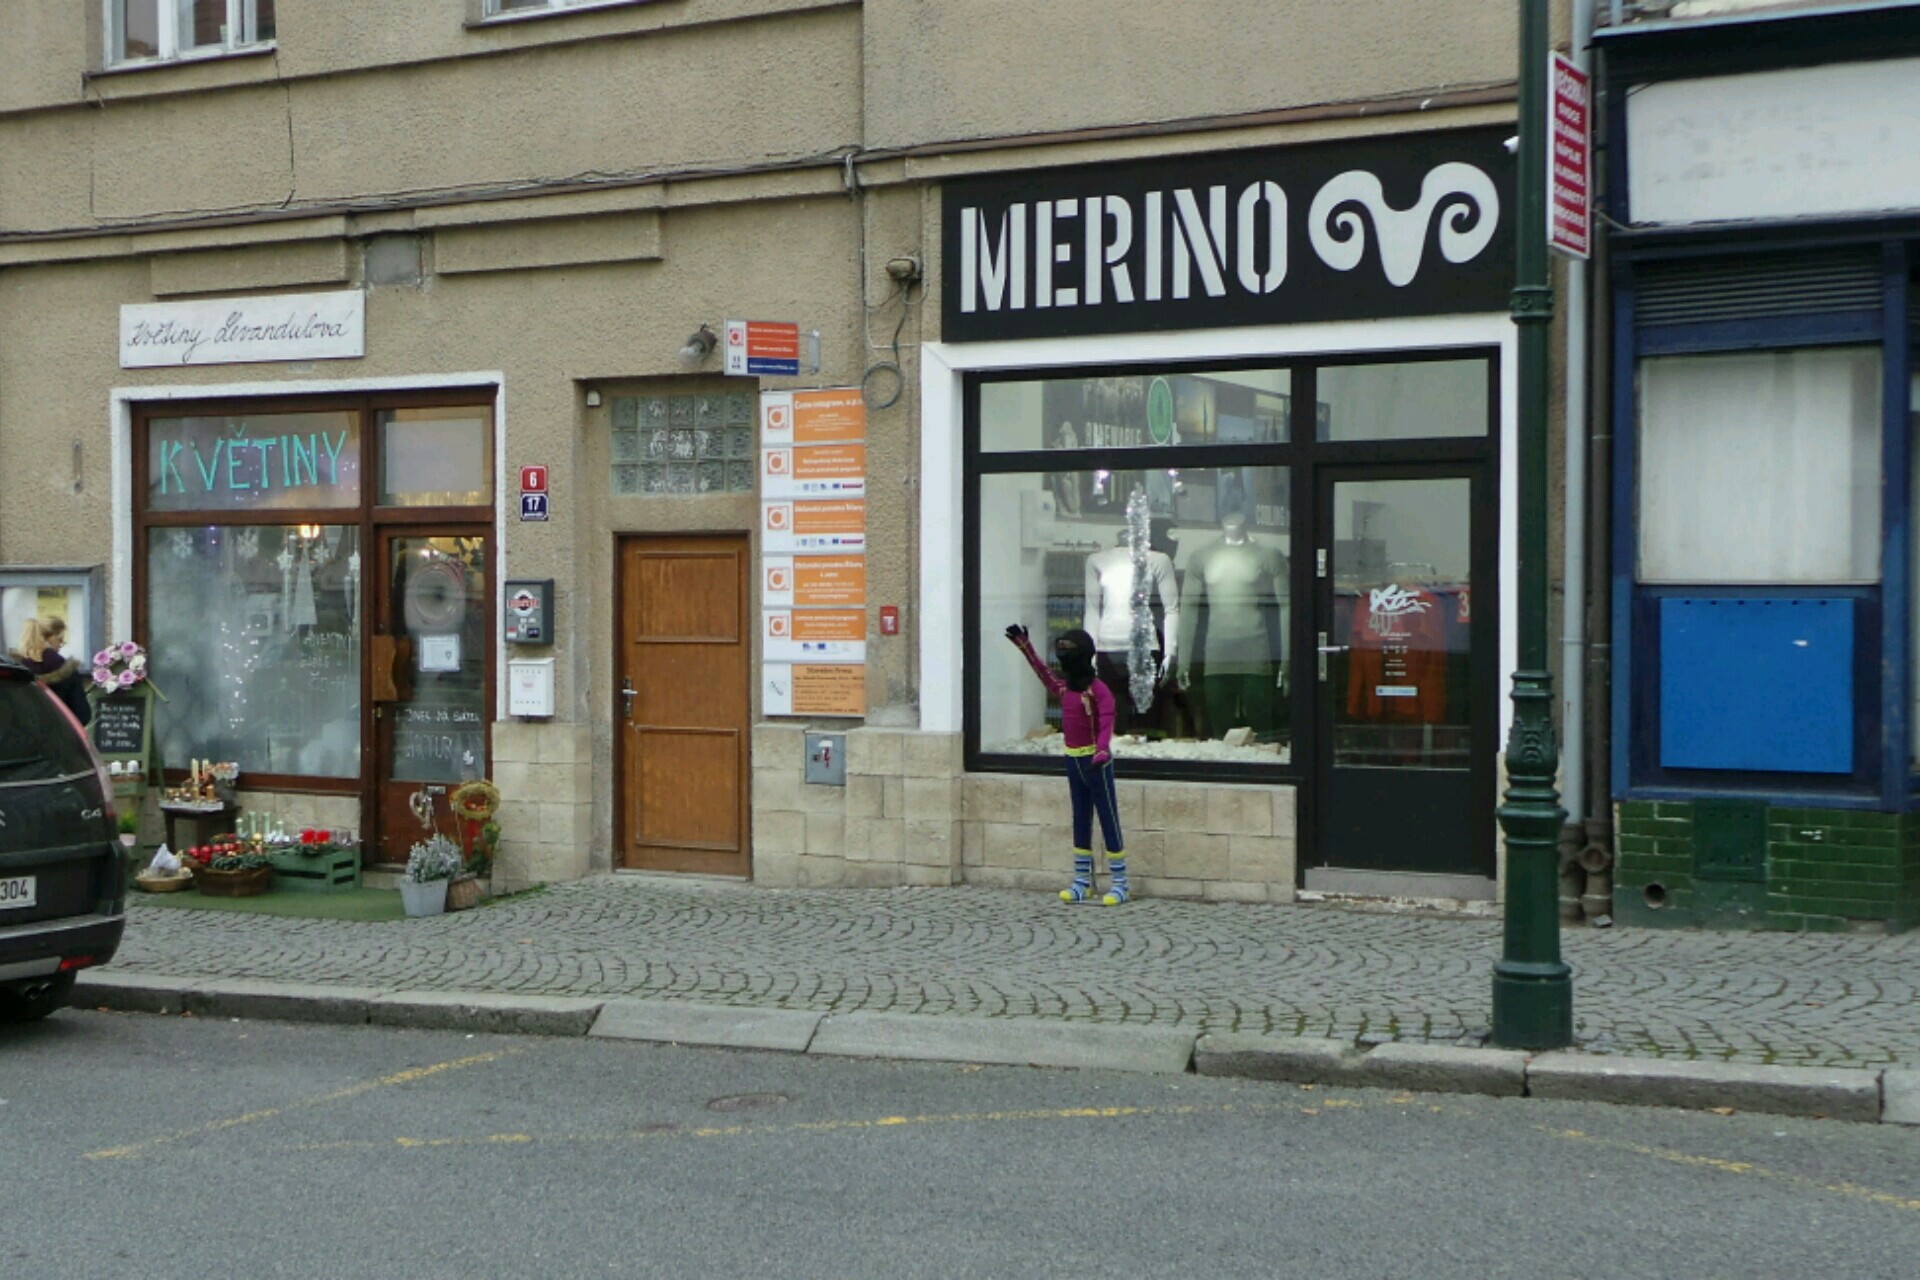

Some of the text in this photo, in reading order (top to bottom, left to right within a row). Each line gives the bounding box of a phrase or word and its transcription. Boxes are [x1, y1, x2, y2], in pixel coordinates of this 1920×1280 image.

[960, 180, 1289, 313] MERINO
[213, 310, 354, 345] Levandulová
[159, 422, 348, 494] KVĚTINY
[529, 471, 538, 488] 6
[526, 496, 541, 511] 17
[0, 879, 28, 901] 304
